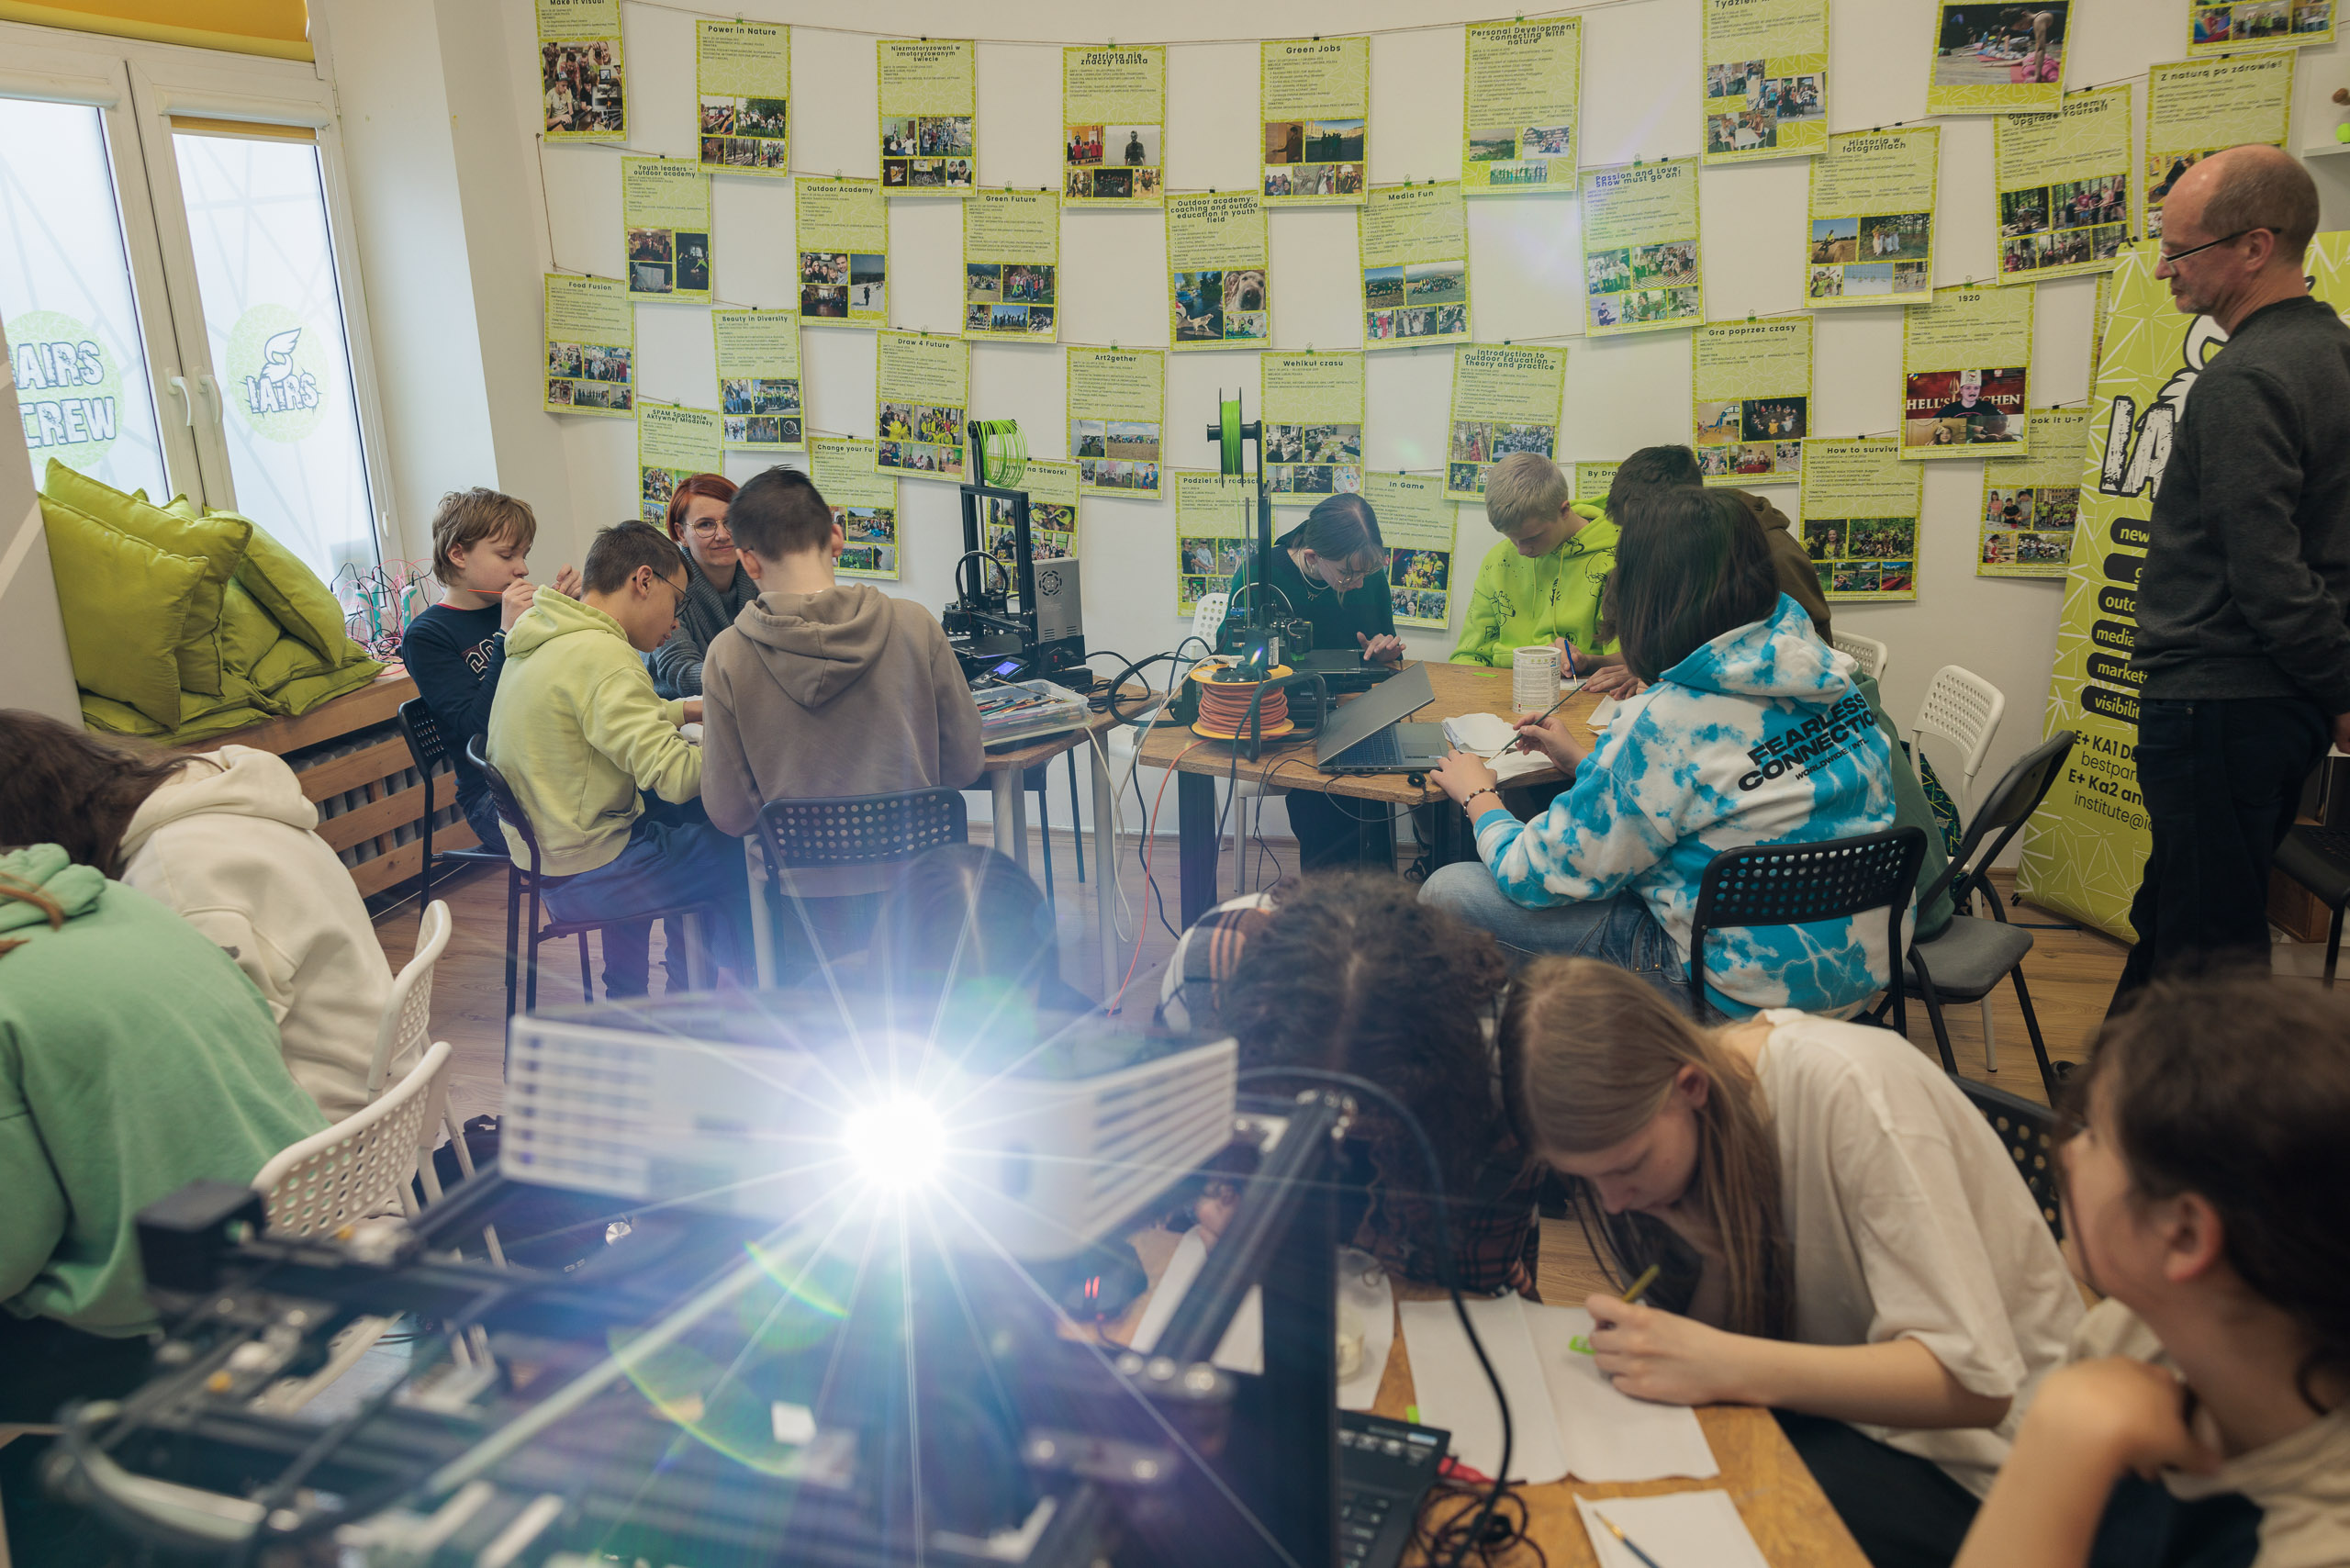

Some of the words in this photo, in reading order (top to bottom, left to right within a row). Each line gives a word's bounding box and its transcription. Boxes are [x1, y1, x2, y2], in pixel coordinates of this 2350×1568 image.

[708, 25, 733, 33] Power
[736, 26, 744, 34] in
[747, 28, 777, 36] Nature
[1471, 27, 1511, 37] Personal
[1514, 23, 1576, 34] Development
[1490, 31, 1541, 41] connecting
[1545, 28, 1565, 38] with
[1285, 46, 1315, 54] Green
[1317, 44, 1341, 52] Jobs
[1086, 51, 1125, 60] Patriota
[1080, 58, 1113, 66] znaczy
[1115, 56, 1148, 64] rasista
[2212, 67, 2229, 77] po
[1848, 137, 1889, 147] Historia
[663, 171, 696, 179] academy
[1595, 173, 1632, 183] Passion
[1635, 168, 1653, 177] and
[1623, 175, 1648, 185] must
[1651, 174, 1662, 182] go
[1665, 169, 1682, 179] on!
[839, 185, 874, 195] Academy
[1388, 192, 1416, 201] Media
[1177, 198, 1211, 207] Outdoor
[1170, 204, 1208, 213] coaching
[1210, 203, 1226, 211] and
[1177, 210, 1218, 219] education
[1231, 207, 1256, 217] youth
[568, 281, 587, 289] Food
[588, 283, 612, 291] Fusion
[1957, 294, 1981, 302] 1920
[722, 315, 746, 323] Beauty
[756, 315, 789, 323] Diversity
[1729, 325, 1766, 337] poprzez
[1768, 324, 1796, 332] czasy
[897, 338, 917, 346] Draw
[925, 341, 951, 349] Future
[1094, 354, 1137, 363] Art2gether
[1477, 348, 1533, 359] Introduction
[1464, 353, 1501, 363] Outdoor
[1503, 355, 1548, 365] Education
[1465, 359, 1494, 369] theory
[1516, 362, 1555, 371] practice
[652, 409, 671, 417] SPAM
[673, 410, 708, 420] Spotkanie
[817, 443, 845, 453] Change
[846, 445, 862, 454] your
[1863, 445, 1898, 454] survive
[1038, 466, 1068, 476] Stworki
[1587, 470, 1599, 478] By
[1400, 481, 1425, 490] Game
[1746, 692, 1868, 767] FEARLESS
[1795, 745, 1850, 781] WORLDWIDE
[2068, 767, 2086, 784] E+
[2088, 775, 2120, 798] Ka2
